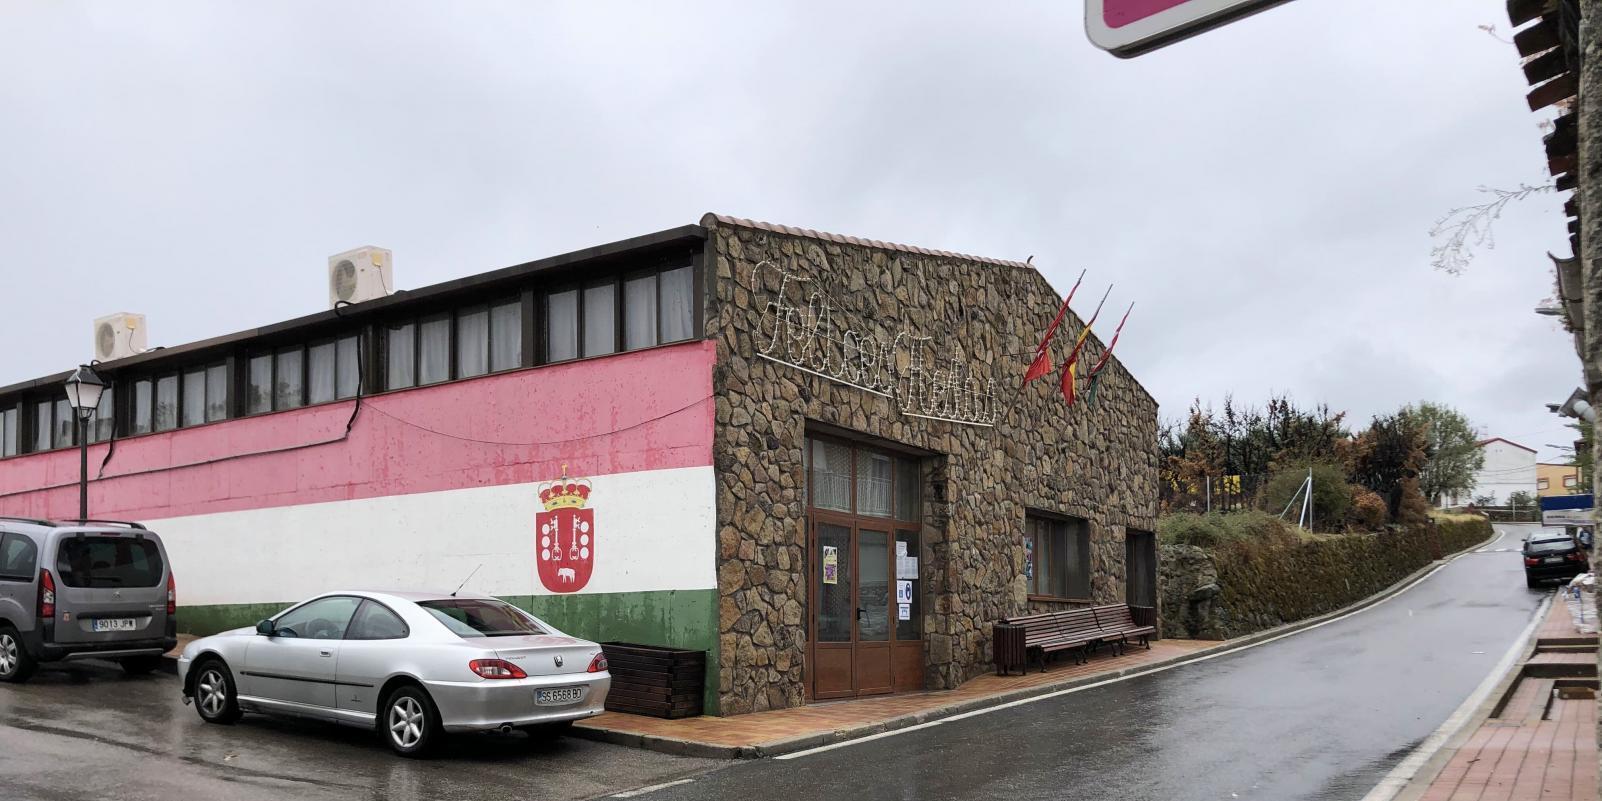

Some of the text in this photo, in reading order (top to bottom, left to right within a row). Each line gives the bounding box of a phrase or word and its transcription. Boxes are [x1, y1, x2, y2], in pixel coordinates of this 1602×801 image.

[752, 260, 997, 424] Felices Fiestas
[99, 620, 118, 628] 9013
[542, 688, 582, 702] SS 6568 BD
